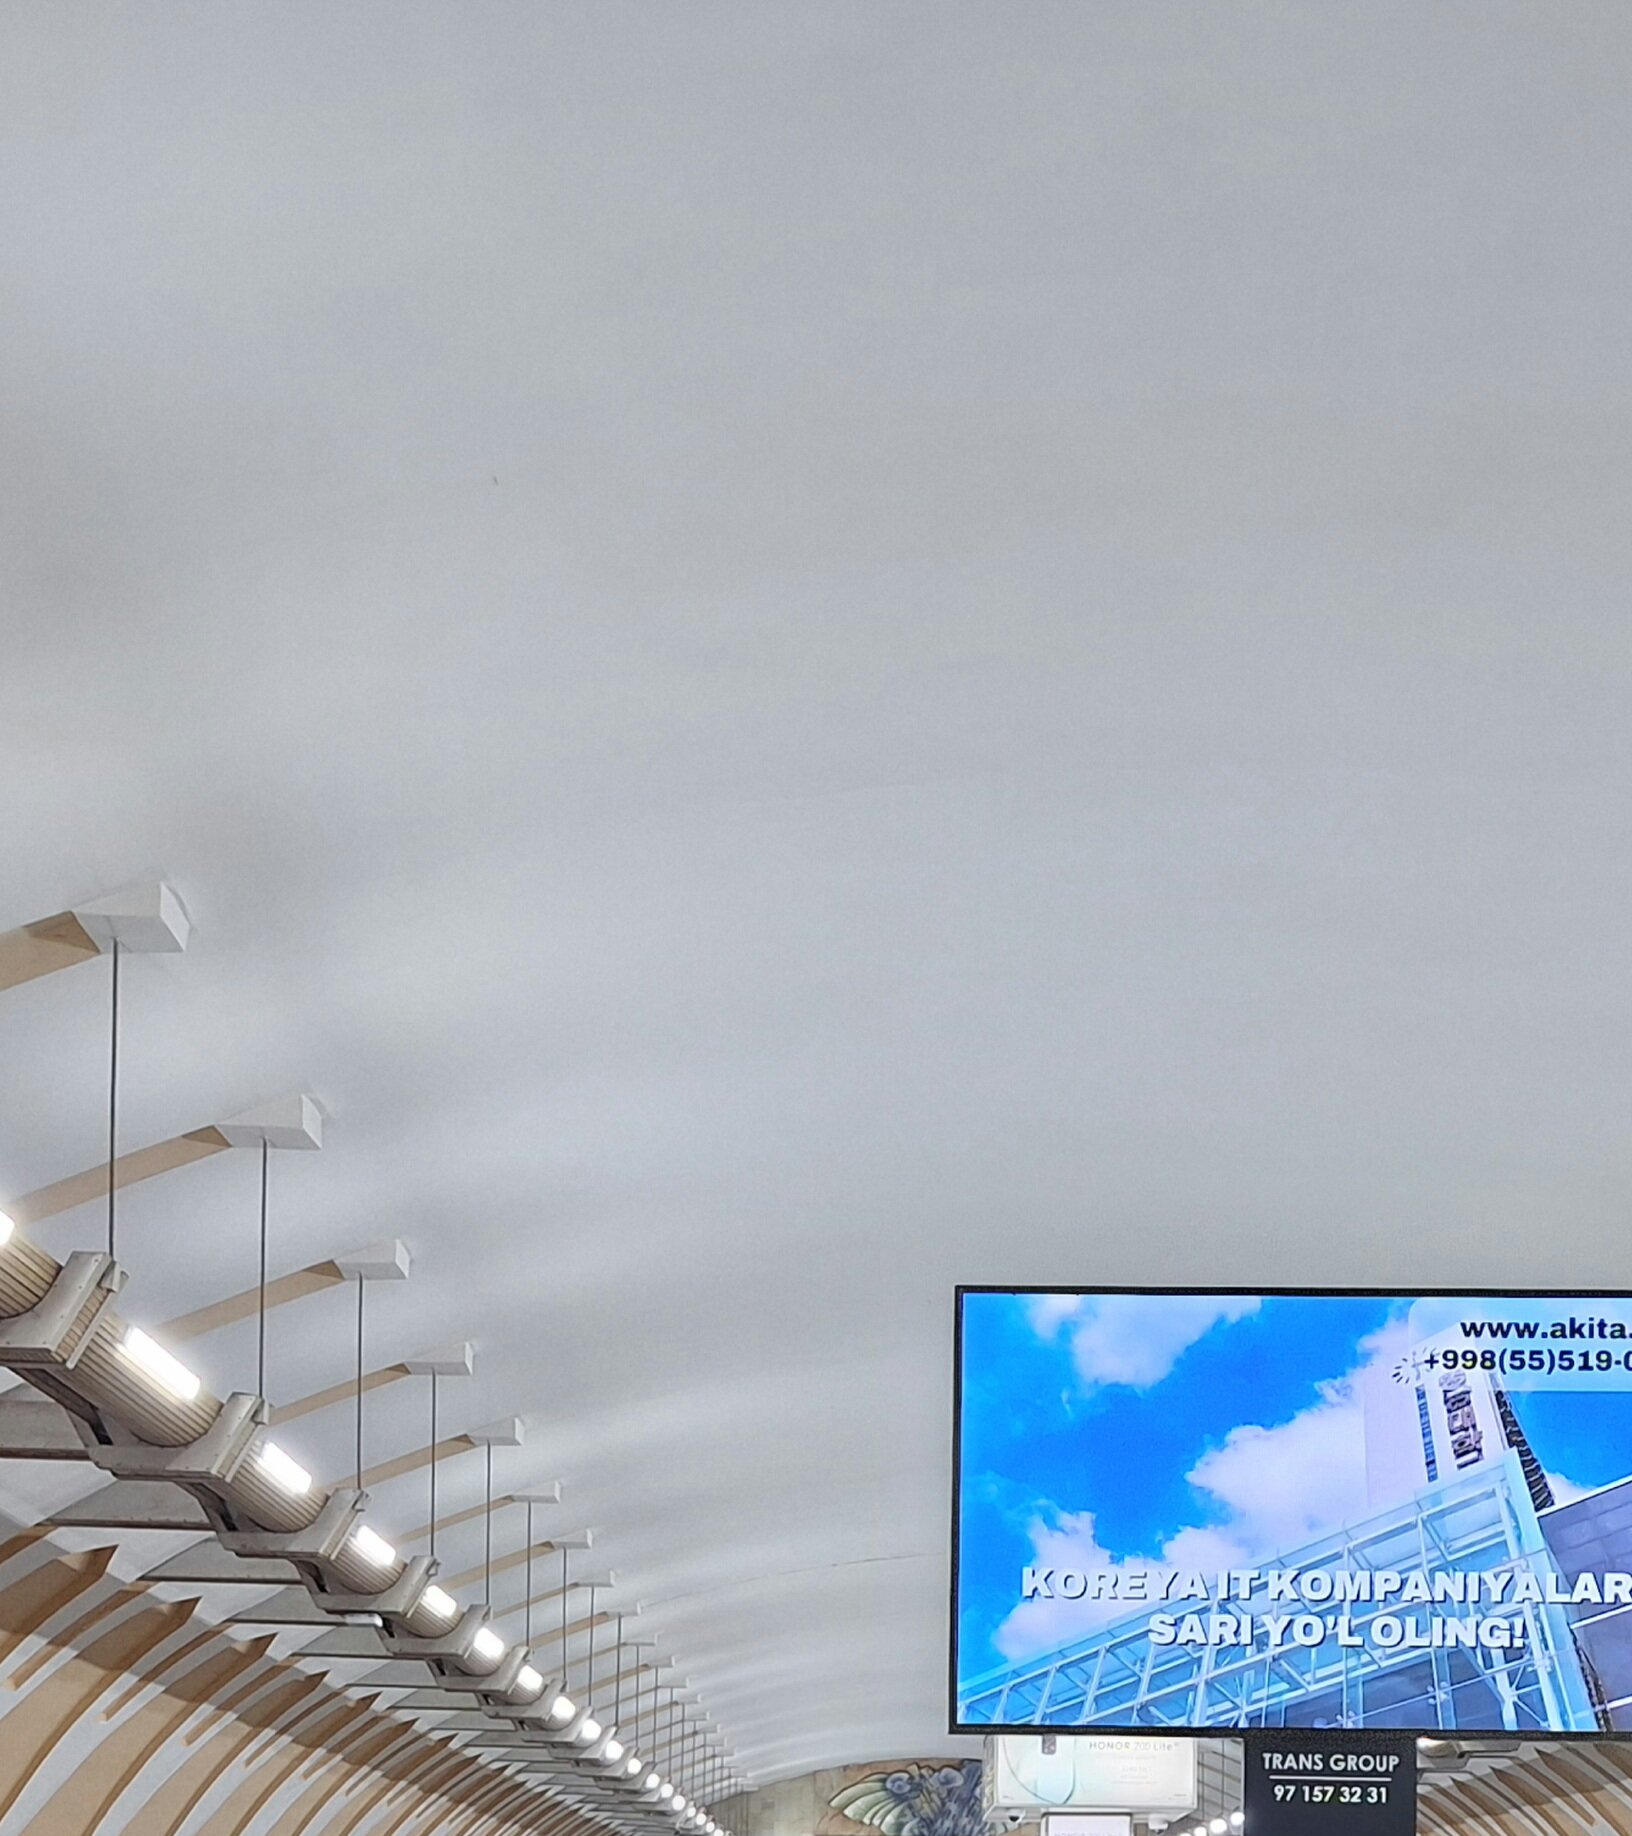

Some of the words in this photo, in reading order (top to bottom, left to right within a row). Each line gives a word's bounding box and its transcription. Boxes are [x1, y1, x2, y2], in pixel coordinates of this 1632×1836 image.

[1022, 1567, 1209, 1600] KOREYA
[1217, 1569, 1260, 1601] IT
[1148, 1613, 1253, 1646] SARI
[1260, 1614, 1364, 1647] YO'L
[1370, 1616, 1527, 1650] OLING!
[1262, 1752, 1324, 1771] TRANS
[1329, 1753, 1400, 1773] GROUP
[1274, 1784, 1296, 1802] 97
[1302, 1785, 1335, 1803] 157
[1339, 1786, 1362, 1803] 32
[1367, 1786, 1387, 1804] 31
